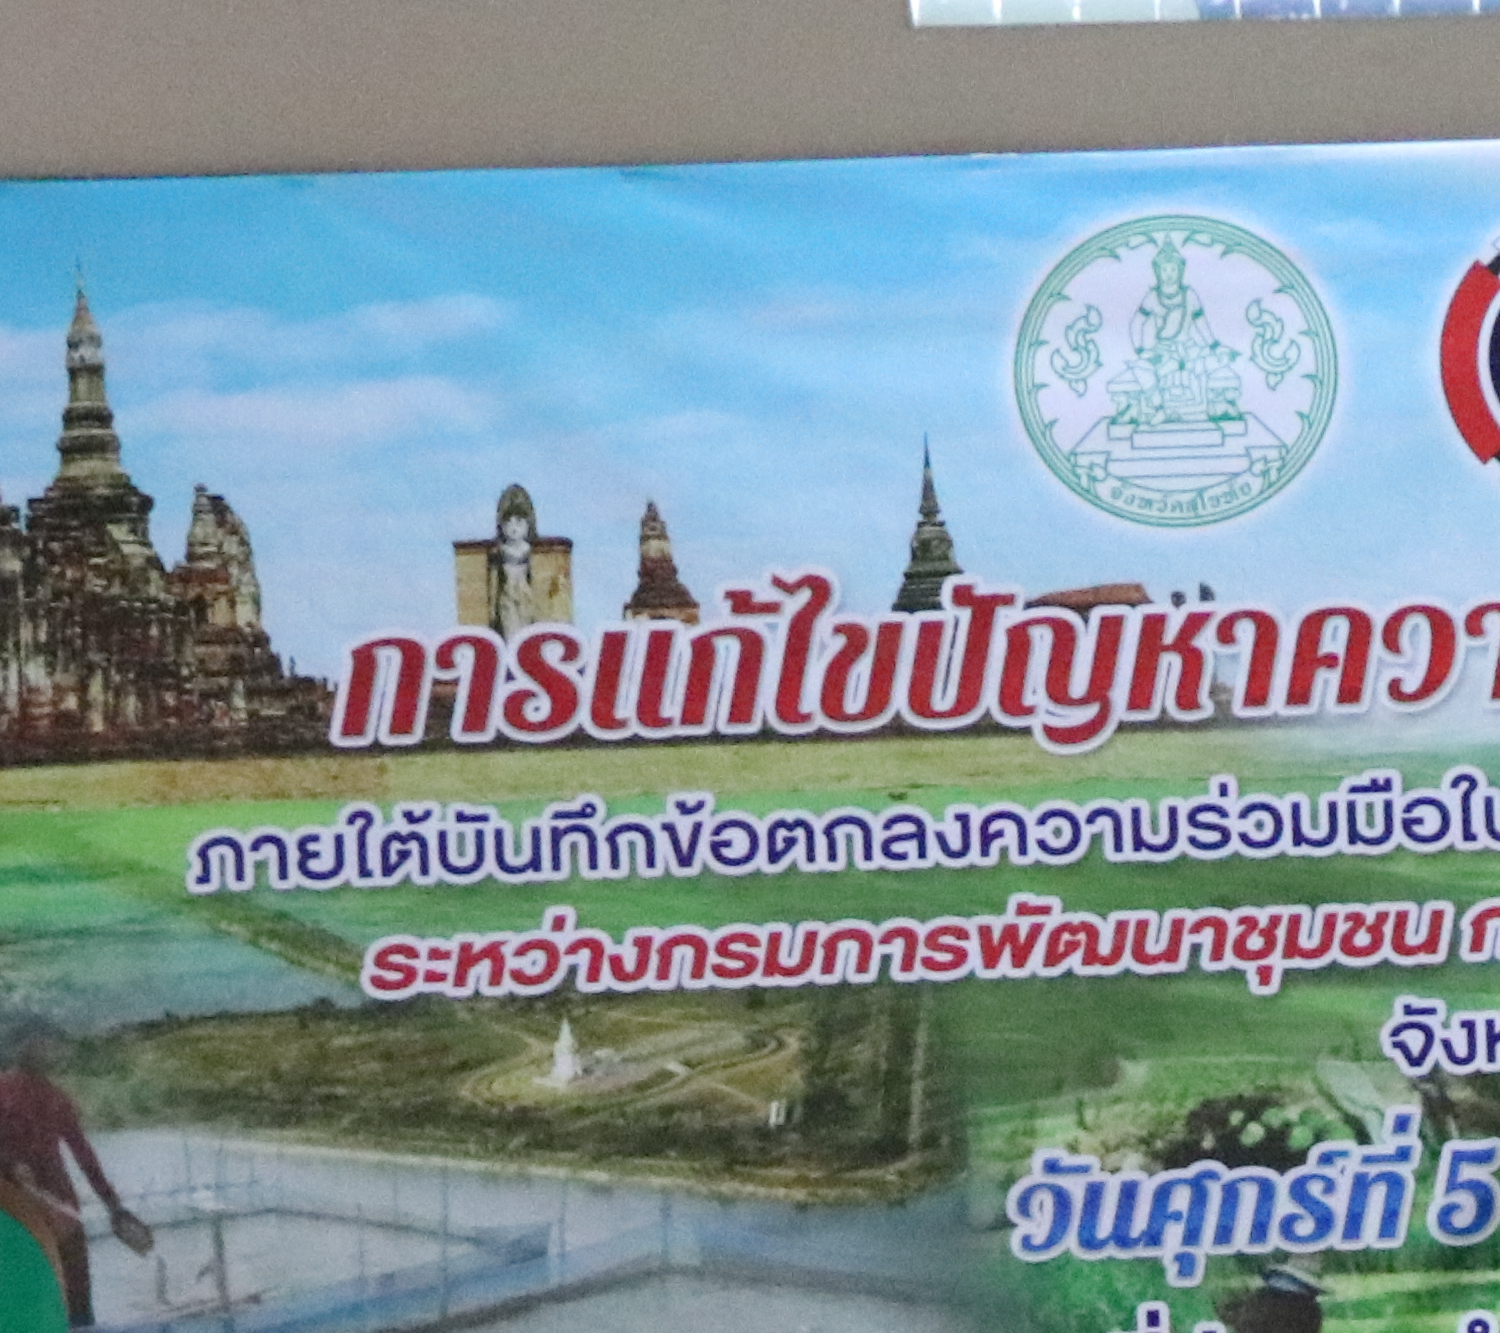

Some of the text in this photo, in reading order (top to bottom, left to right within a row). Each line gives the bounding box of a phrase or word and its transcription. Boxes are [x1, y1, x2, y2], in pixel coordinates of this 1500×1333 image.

[373, 902, 1442, 990] ระหว่างกรมการพัฒนาชุมชน
[1017, 1114, 1414, 1278] วันศุกร์ที่
[1437, 1148, 1497, 1236] 5
